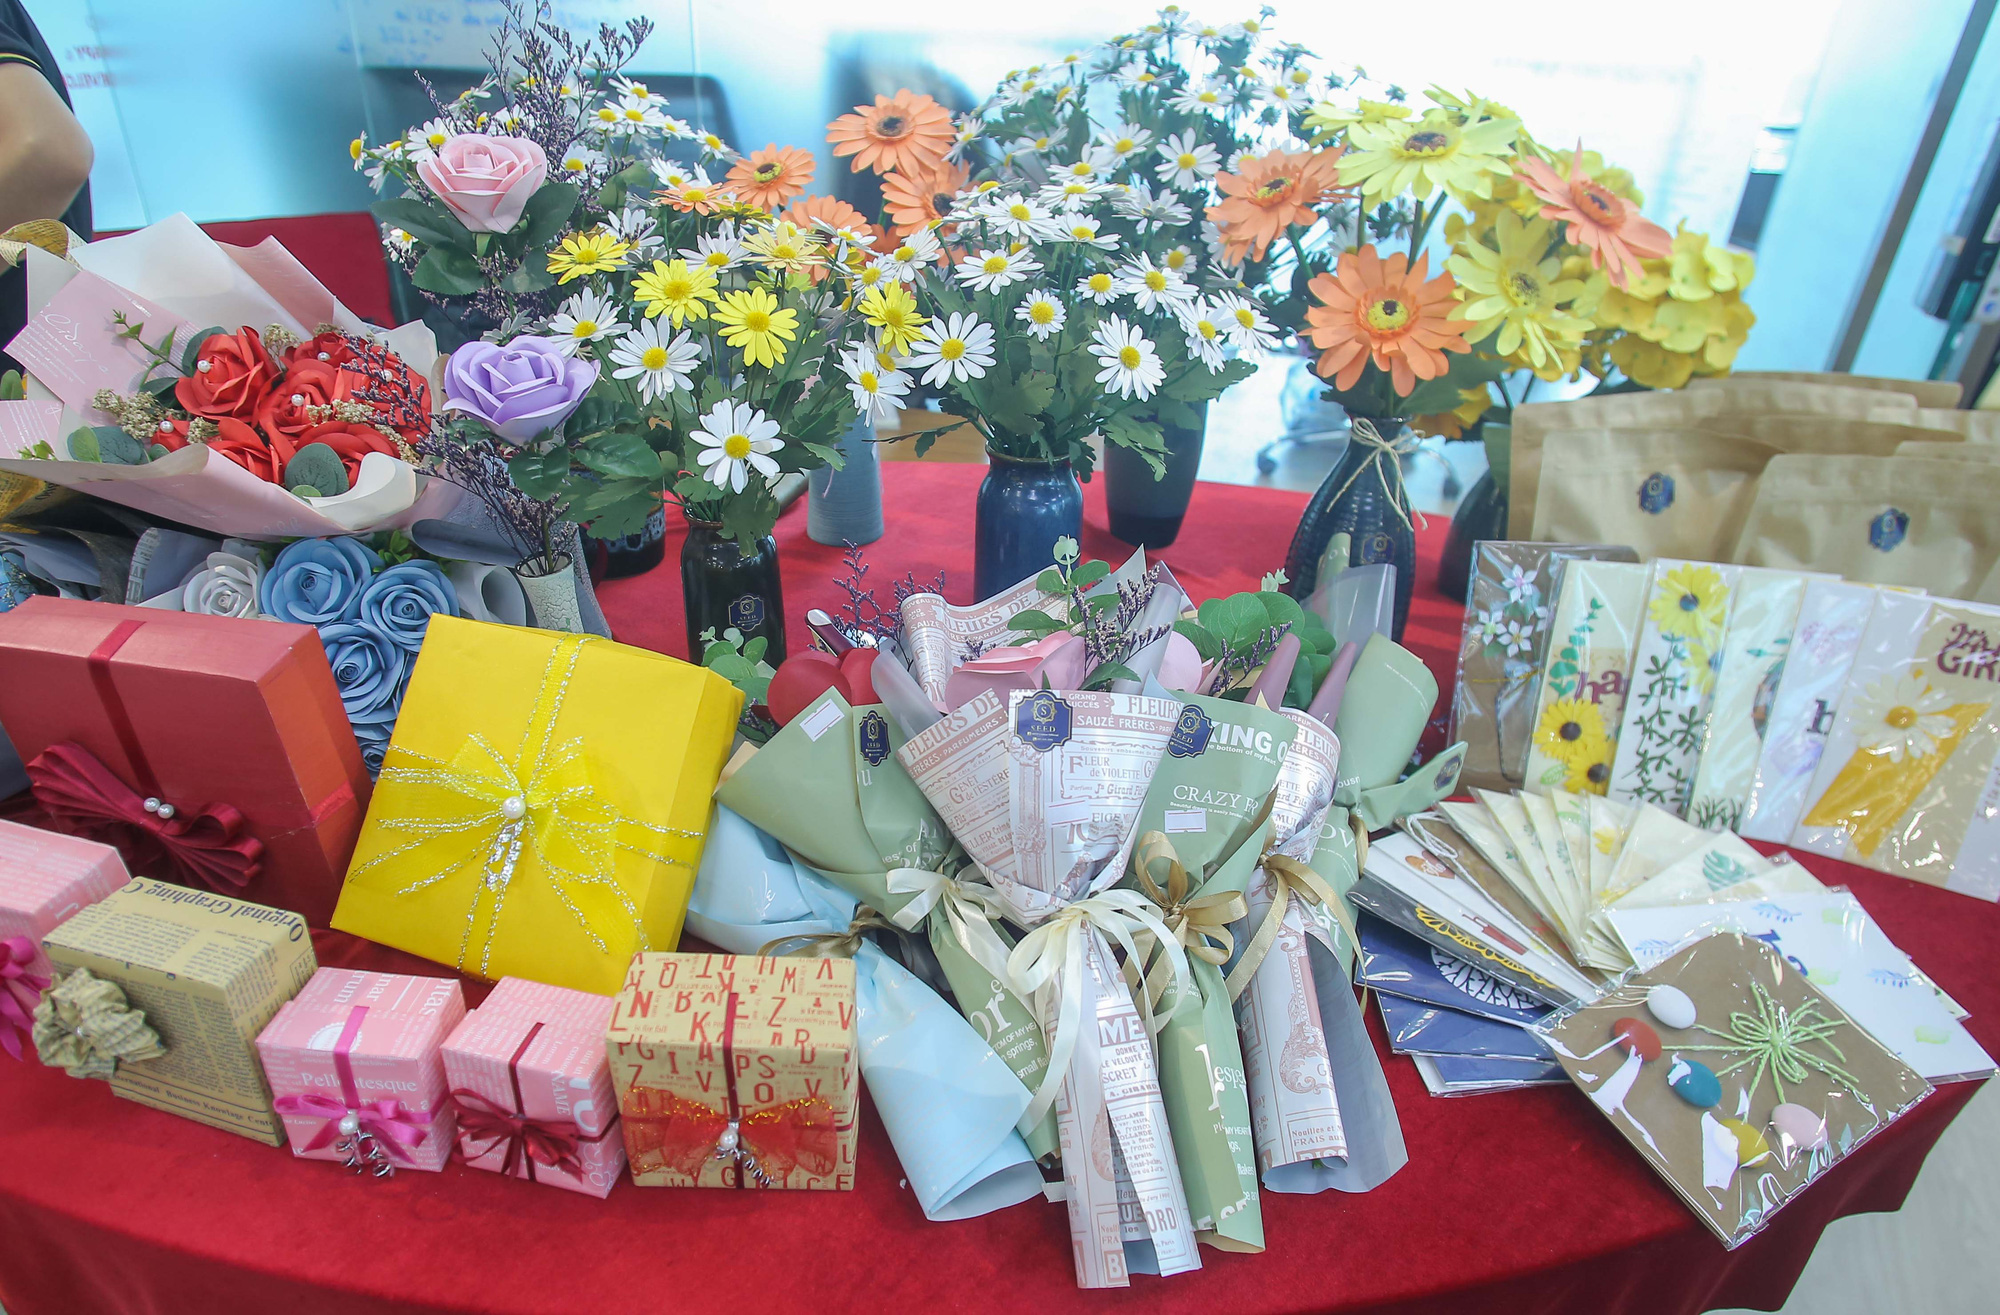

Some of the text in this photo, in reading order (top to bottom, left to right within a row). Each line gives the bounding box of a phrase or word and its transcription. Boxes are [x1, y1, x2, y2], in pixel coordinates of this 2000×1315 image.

[1008, 596, 1032, 617] DE
[1068, 693, 1097, 701] GRAND
[1040, 705, 1047, 716] S
[1127, 695, 1183, 720] FLEURS
[1031, 724, 1056, 733] SEED
[1077, 715, 1115, 727] SAUZÉ
[1119, 717, 1155, 731] FRÈRES
[1185, 719, 1193, 727] S
[905, 710, 969, 760] FLEURS
[943, 718, 999, 756] PARFUMEURS
[1216, 744, 1243, 754] bottom
[1245, 749, 1253, 757] of
[1254, 752, 1264, 762] my
[1069, 755, 1110, 775] FLEUR
[1090, 767, 1140, 780] de VIOLETTE
[1173, 784, 1242, 809] CRAZY
[906, 843, 918, 855] of
[144, 883, 233, 915] Graphing
[233, 904, 304, 943] Original
[301, 1072, 418, 1092] Pelltesque
[1292, 1126, 1325, 1137] Nouilles
[1293, 1135, 1326, 1147] FRAIS
